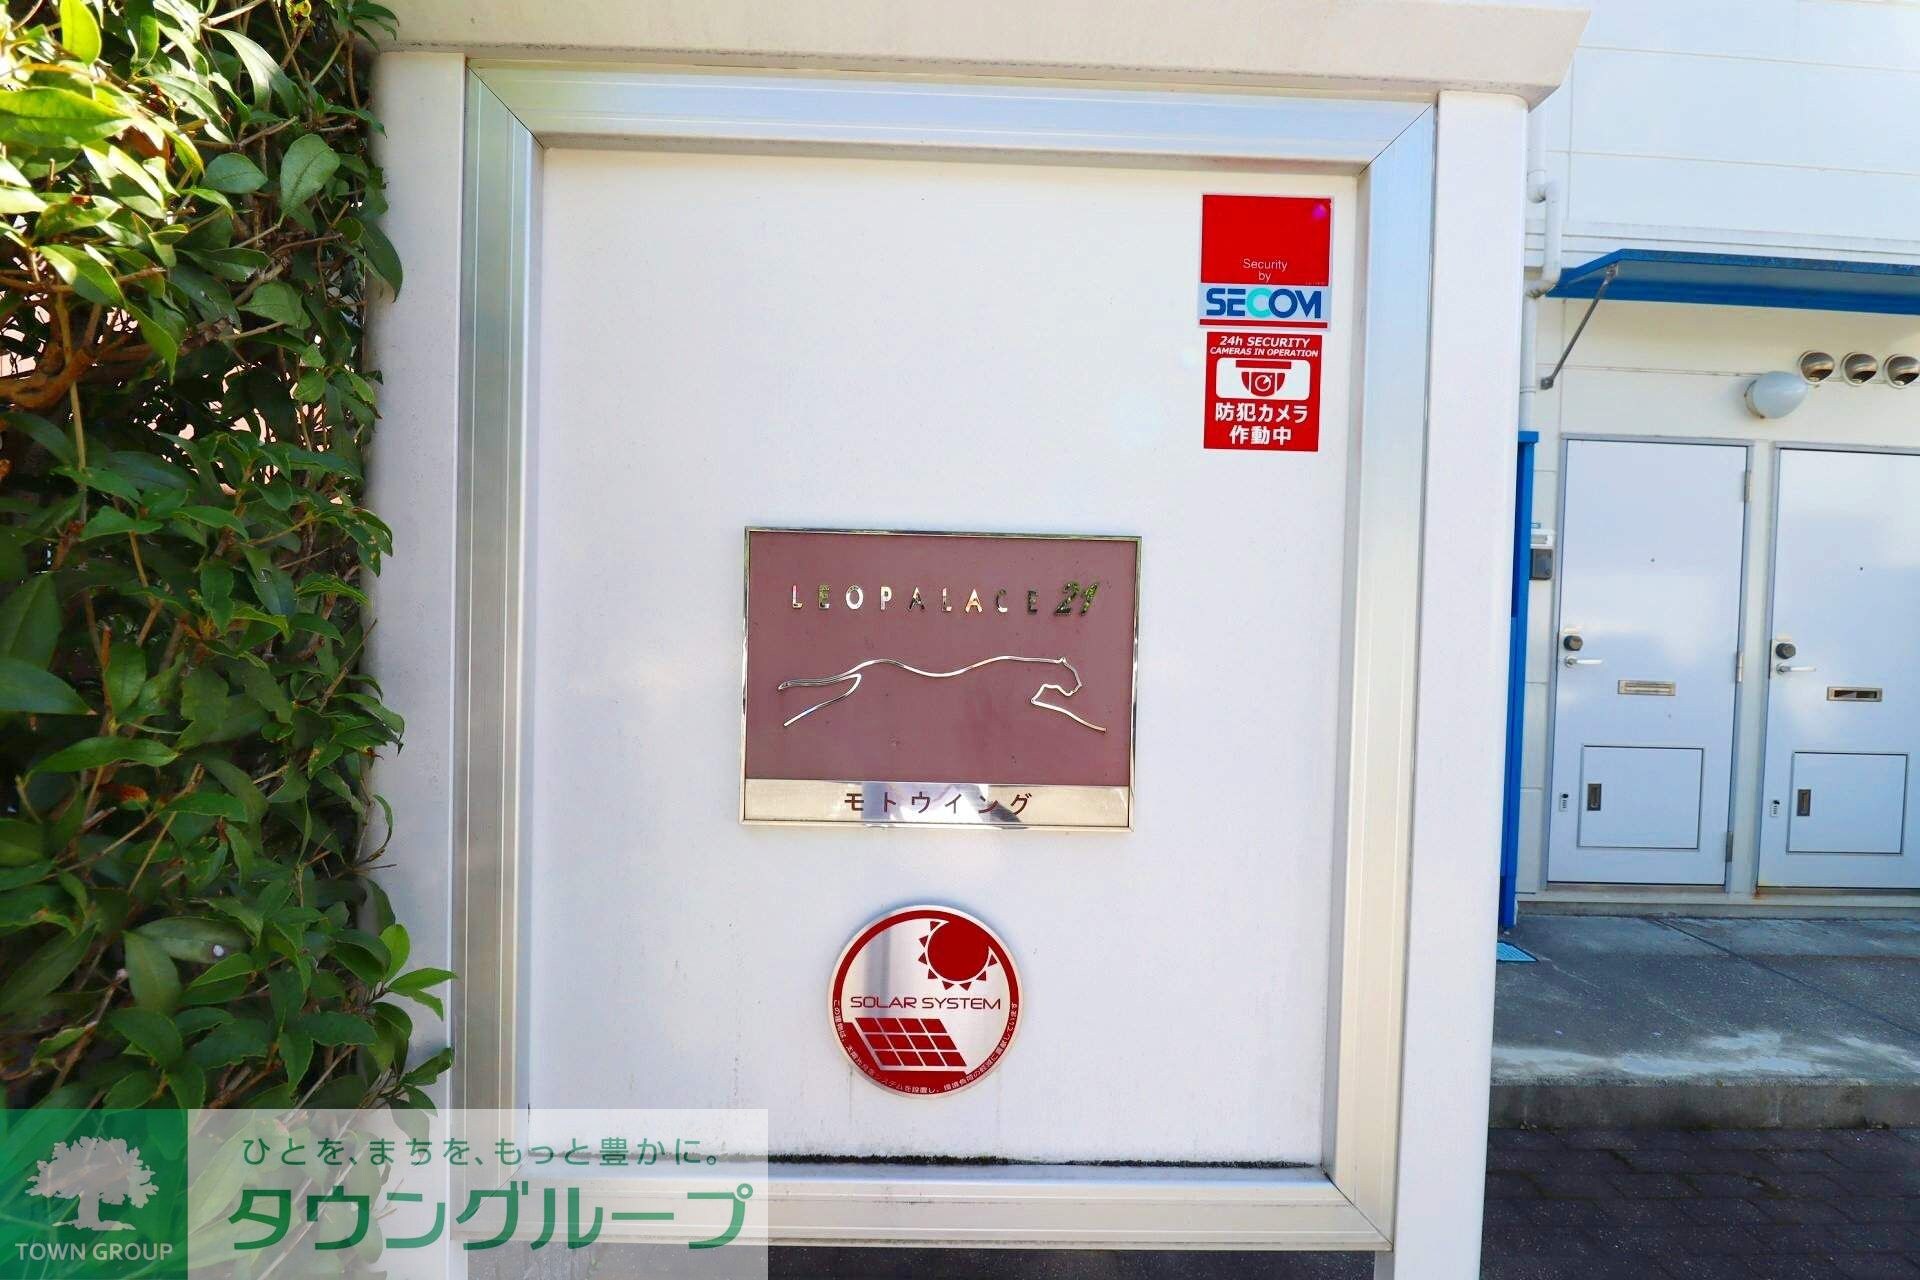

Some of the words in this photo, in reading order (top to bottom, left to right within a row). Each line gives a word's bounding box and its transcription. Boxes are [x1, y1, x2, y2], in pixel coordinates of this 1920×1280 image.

[1243, 258, 1288, 272] Security
[1258, 271, 1271, 282] by
[1206, 287, 1322, 319] SECOM
[1219, 335, 1243, 346] 24h
[1247, 336, 1311, 349] SECURITY
[1210, 346, 1252, 356] CAMERAS
[1254, 348, 1265, 356] IN
[1267, 348, 1319, 358] OPERATION
[1215, 402, 1308, 423] 防犯カメラ
[1229, 425, 1292, 446] 作動中
[792, 584, 1039, 614] LEOPALACE
[1053, 581, 1100, 617] 21
[844, 791, 1033, 815] モトウイング
[850, 996, 916, 1009] SOLAR
[922, 997, 1001, 1010] SYSTEM
